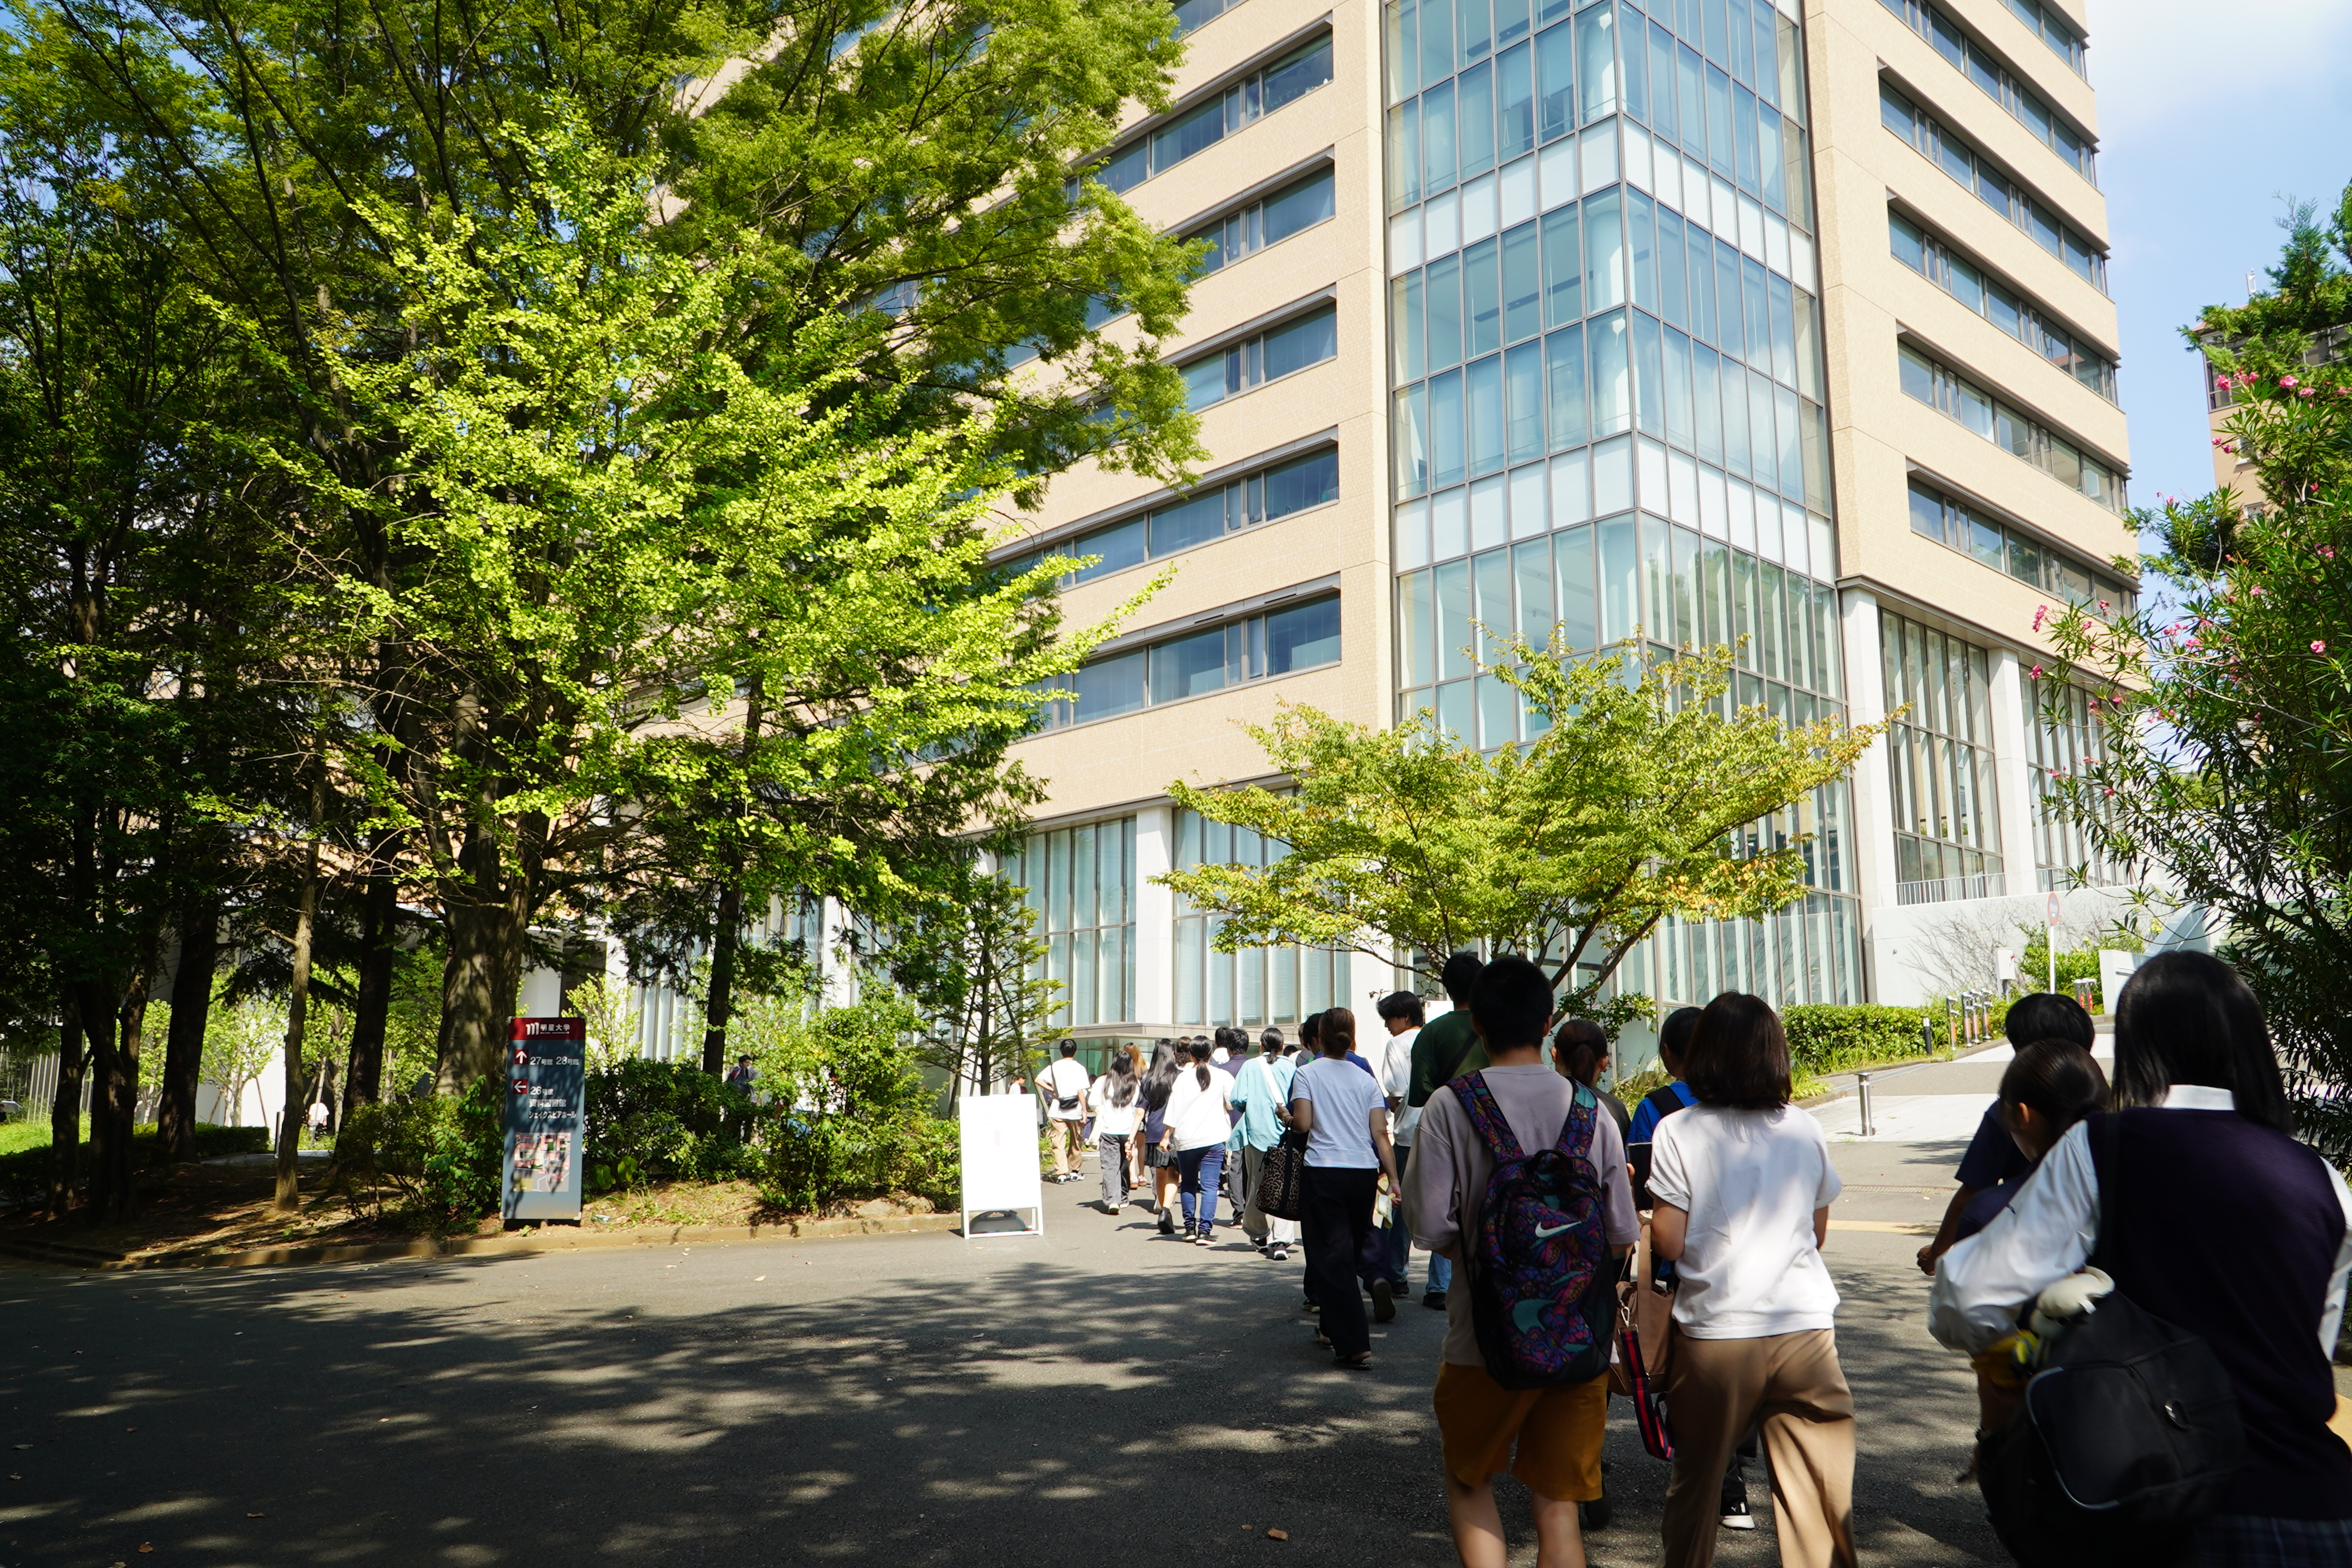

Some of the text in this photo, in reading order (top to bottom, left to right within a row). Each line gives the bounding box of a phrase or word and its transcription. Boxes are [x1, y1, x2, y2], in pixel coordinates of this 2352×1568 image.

[529, 1056, 580, 1065] 27号館 28号館
[529, 1086, 554, 1096] 26号館
